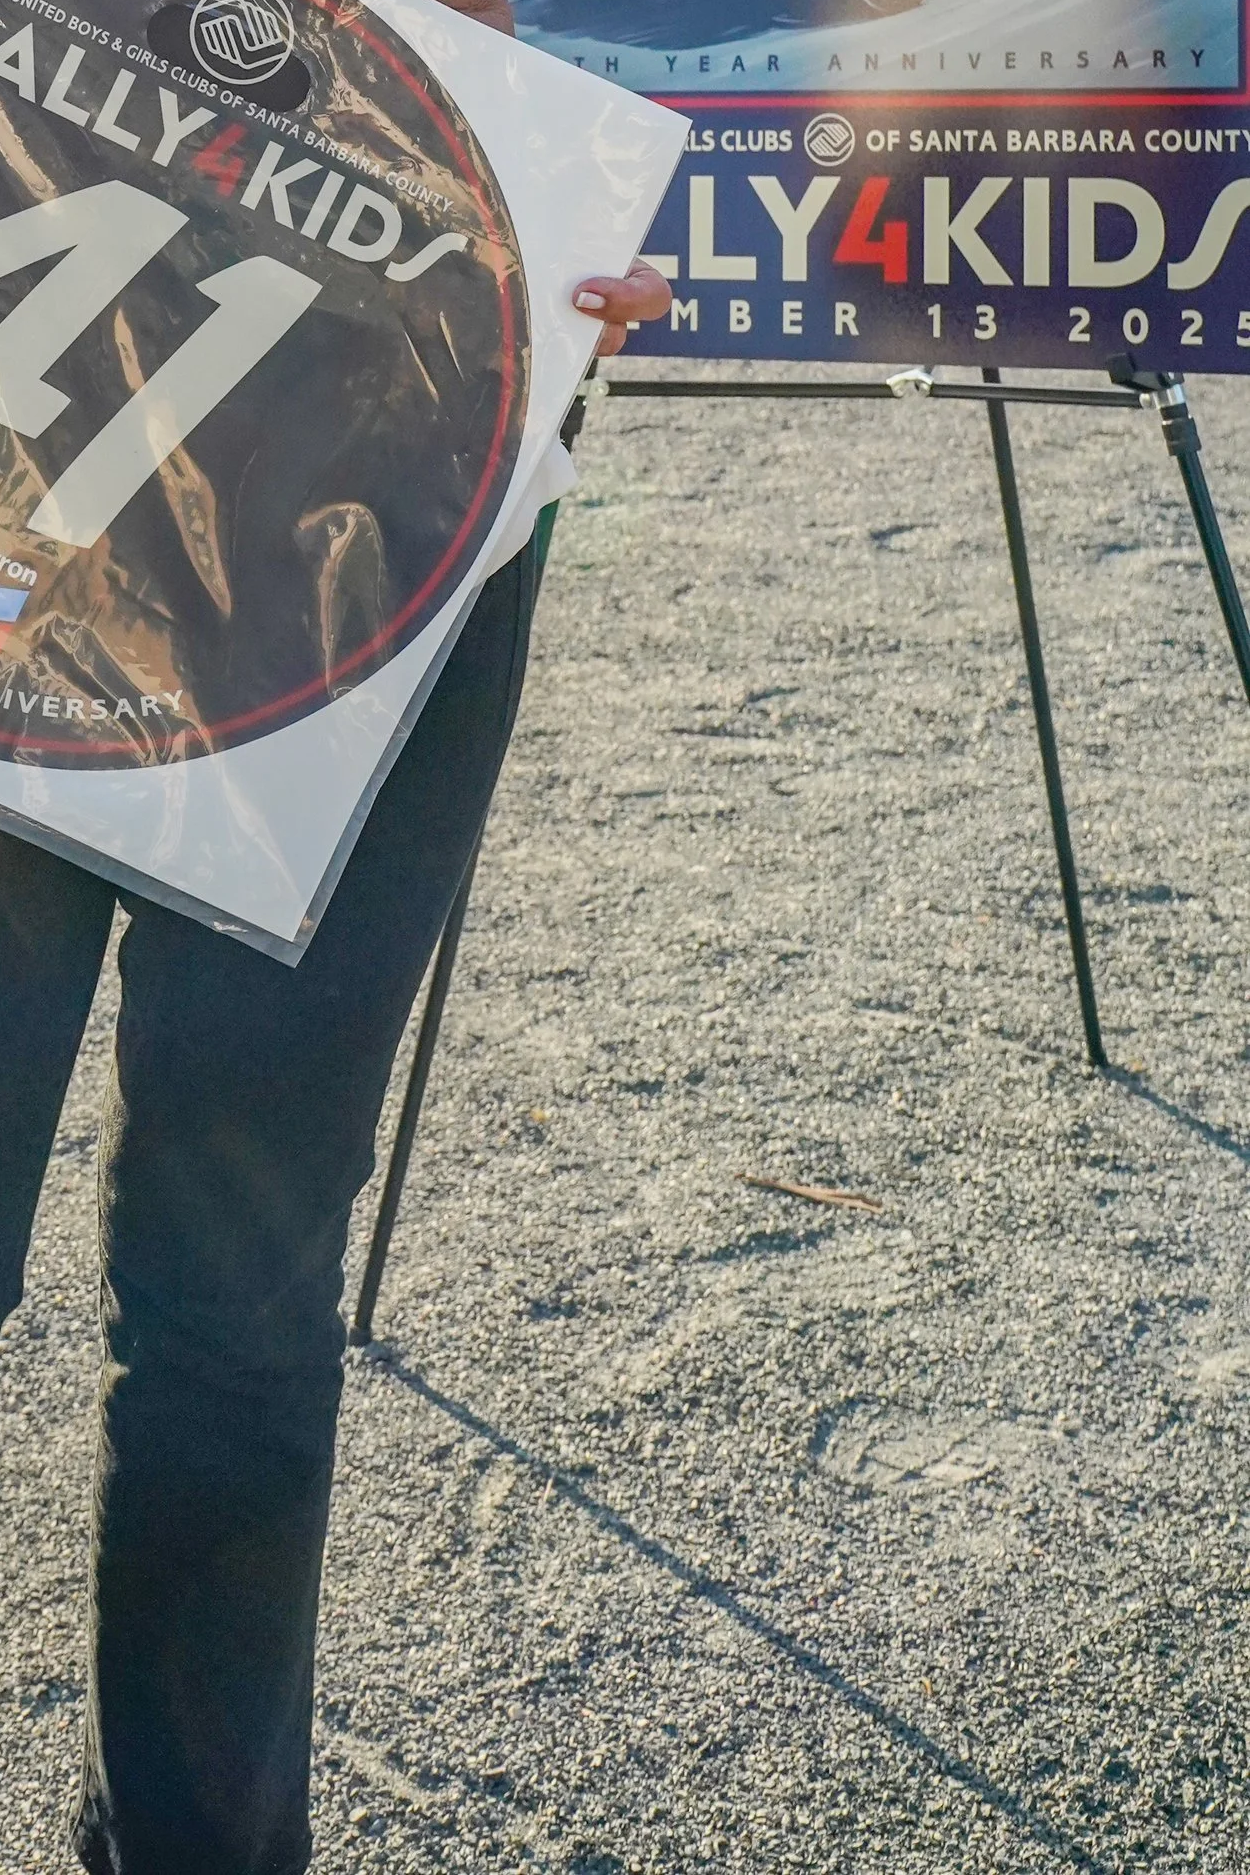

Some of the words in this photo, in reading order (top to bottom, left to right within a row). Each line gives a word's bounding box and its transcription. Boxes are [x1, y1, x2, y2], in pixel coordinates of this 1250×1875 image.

[665, 55, 781, 73] YEAR
[827, 49, 1205, 72] ANNIVERSARY
[67, 15, 110, 44] BOYS
[111, 37, 122, 52] &
[126, 44, 169, 73] GIRLS
[170, 66, 217, 97] CLUBS
[220, 90, 244, 109] OF
[245, 102, 300, 139] SANTA
[304, 130, 381, 179] BARBARA
[385, 171, 454, 213] COUNTY
[720, 130, 793, 152] CLUBS
[865, 130, 901, 152] OF
[908, 130, 996, 153] SANTA
[1006, 130, 1136, 153] BARBARA
[637, 175, 1250, 291] LY4KIDS
[626, 299, 859, 337] MBER
[927, 303, 998, 341] 13
[1068, 307, 1250, 347] 2025
